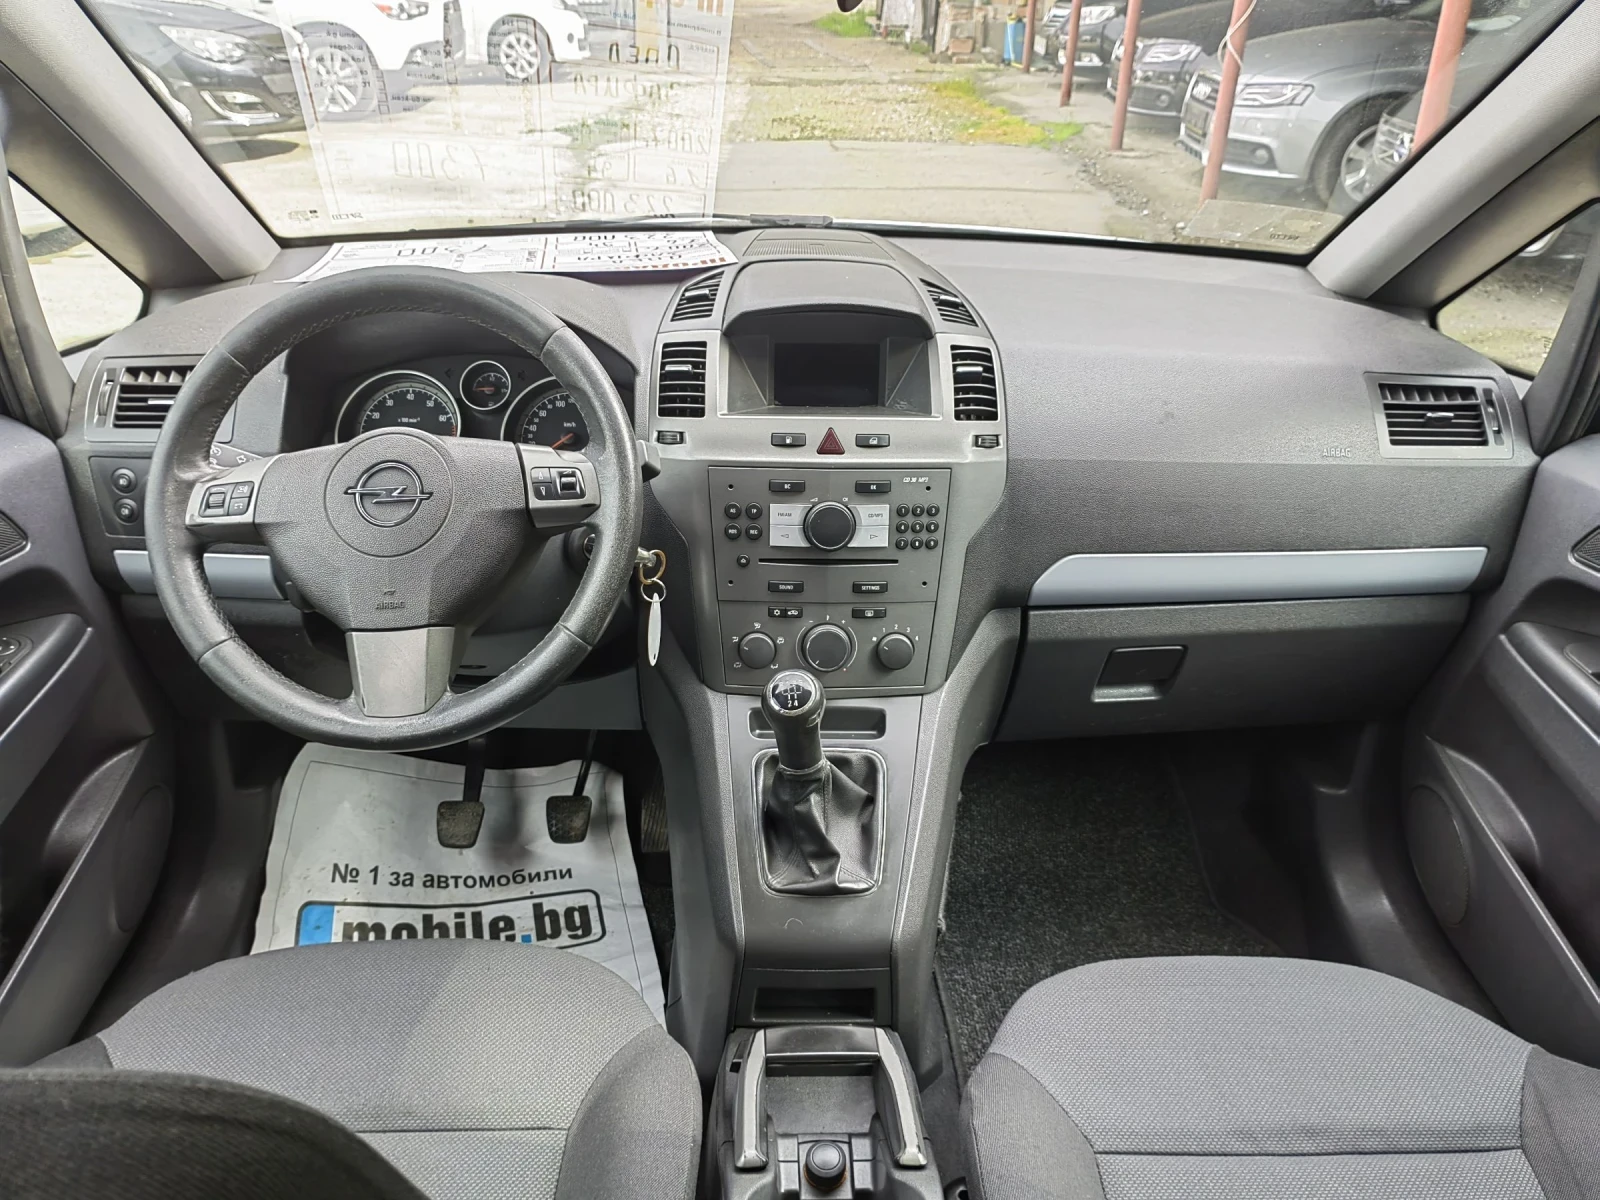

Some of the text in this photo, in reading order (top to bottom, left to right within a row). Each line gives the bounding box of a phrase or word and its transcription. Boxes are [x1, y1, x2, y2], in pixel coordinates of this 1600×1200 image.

[555, 400, 566, 408] 100
[529, 424, 537, 432] 40
[1322, 447, 1352, 458] AIRBAG
[368, 865, 380, 885] 1
[389, 869, 415, 887] за
[422, 865, 574, 890] автомобили
